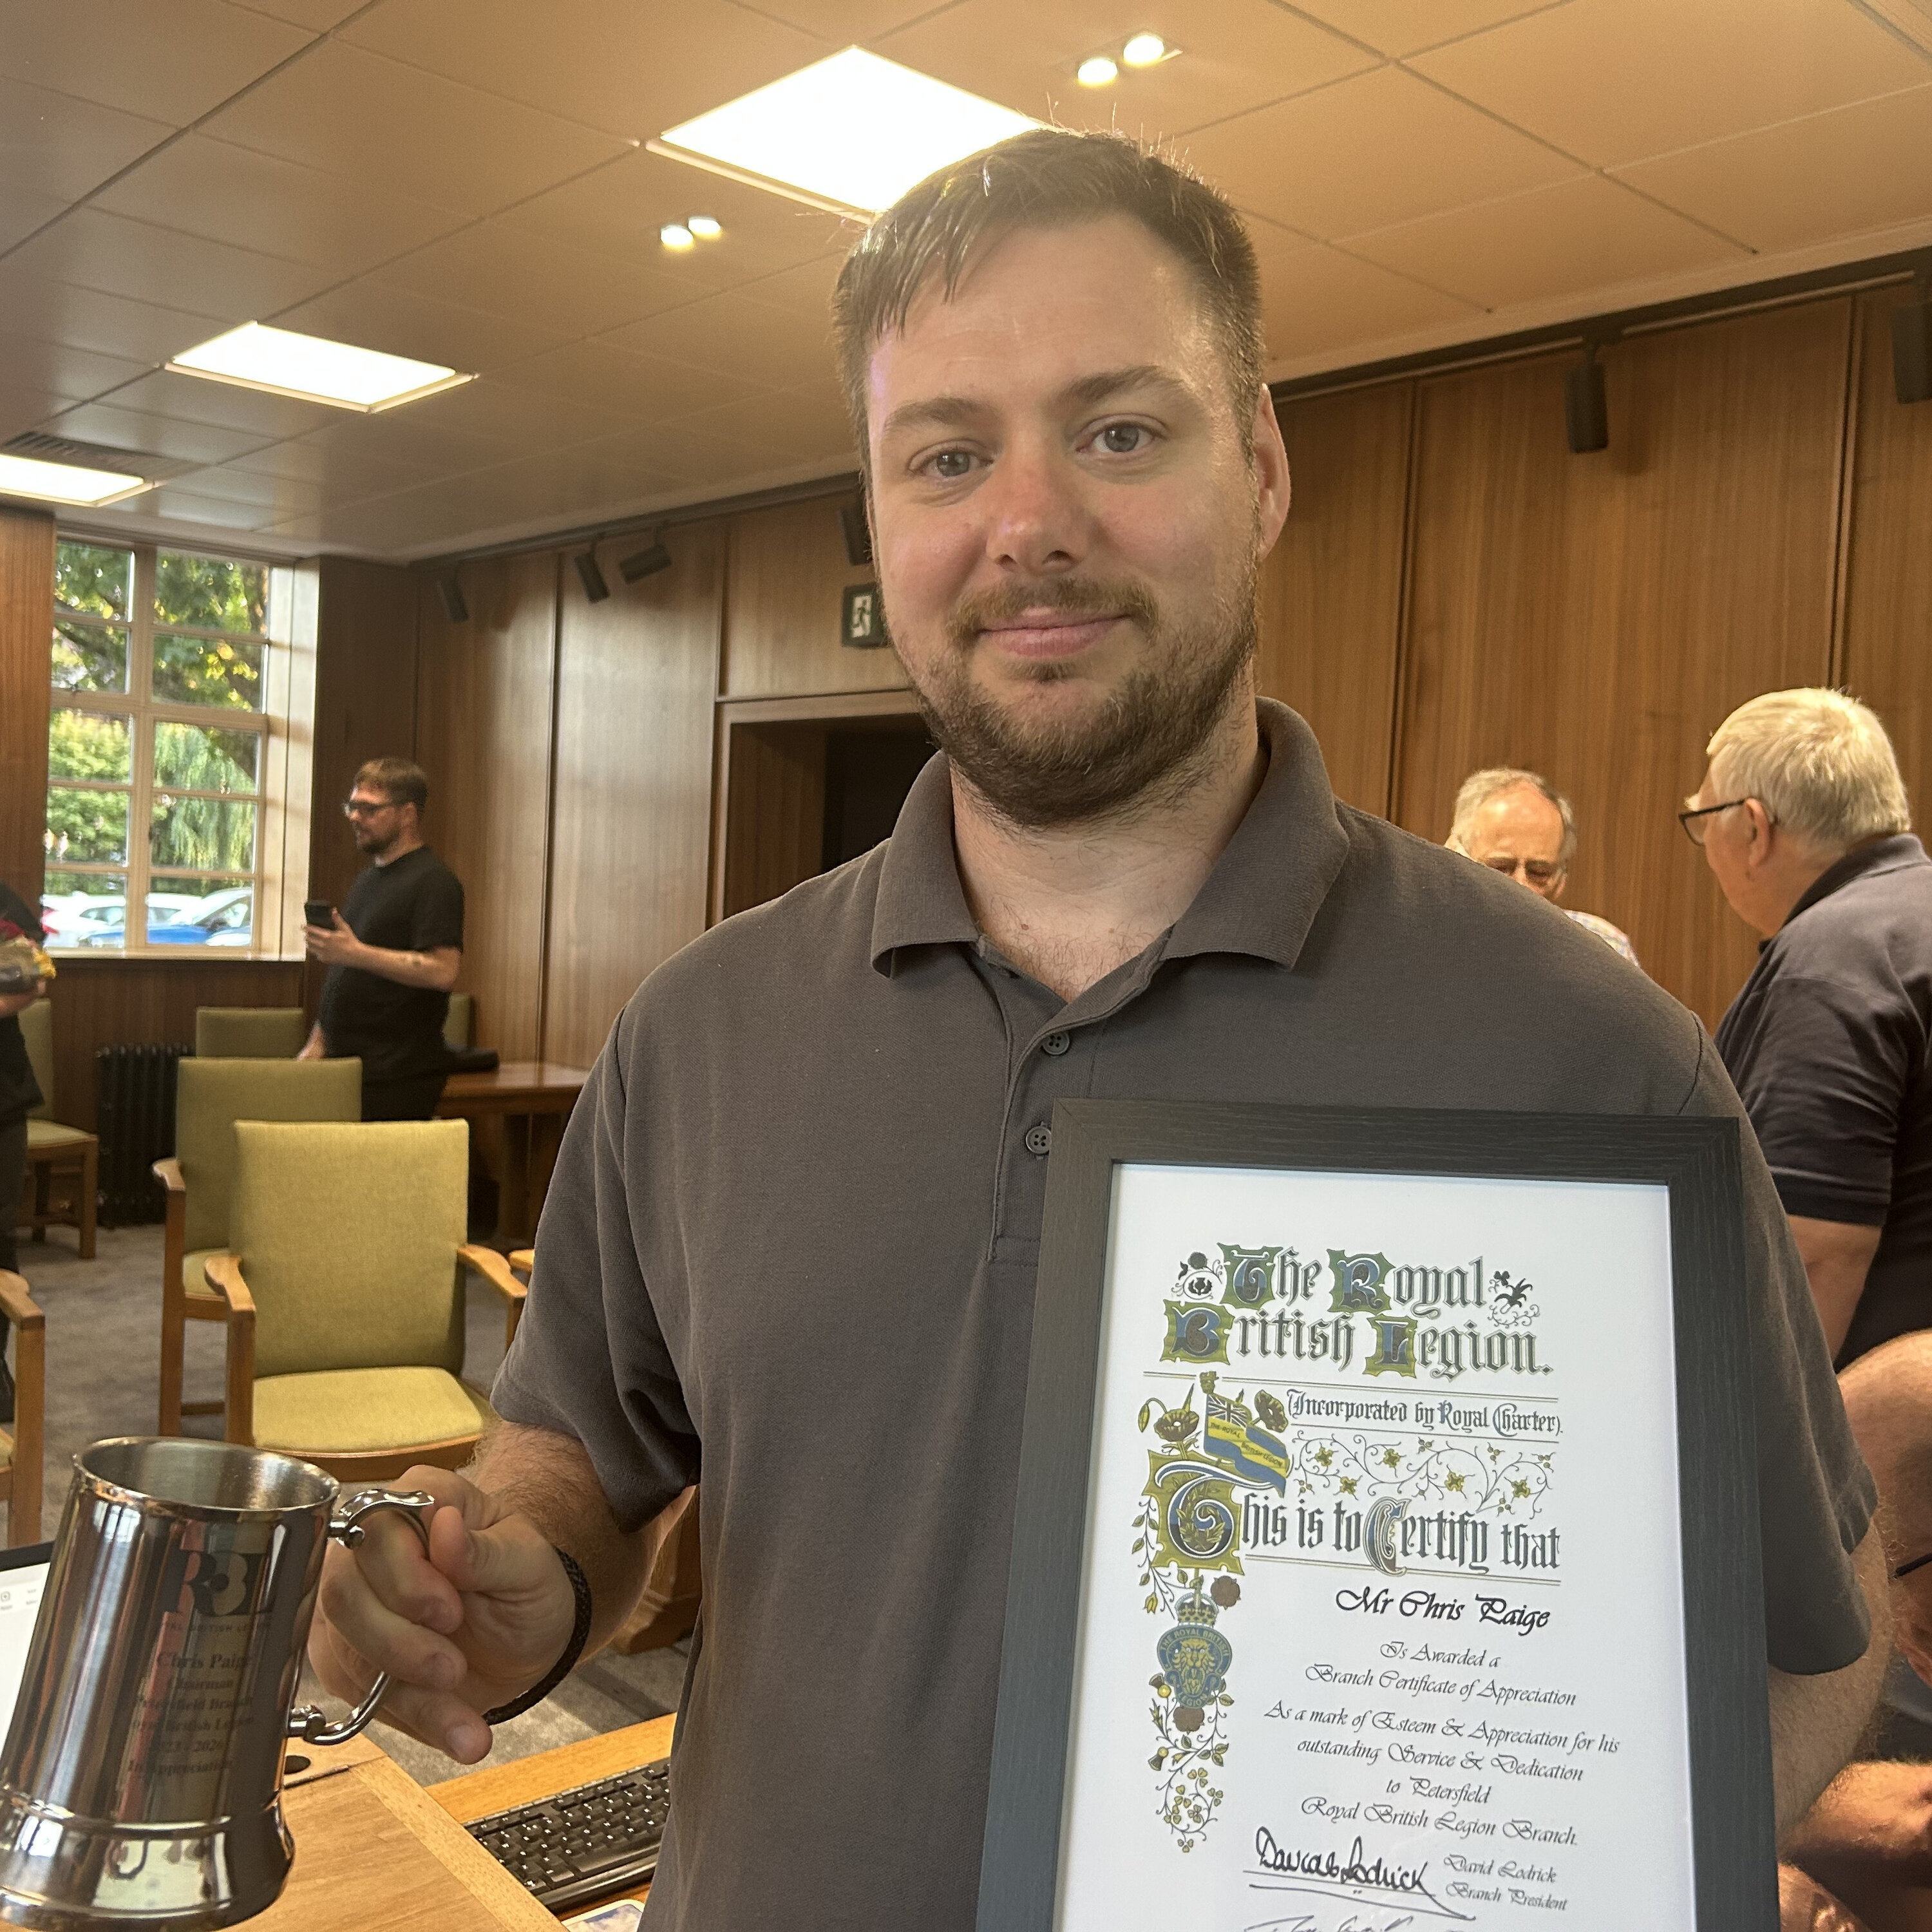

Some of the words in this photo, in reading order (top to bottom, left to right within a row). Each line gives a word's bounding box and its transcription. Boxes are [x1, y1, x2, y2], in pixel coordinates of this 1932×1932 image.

[1224, 1244, 1322, 1307] The
[1331, 1251, 1486, 1320] Royal
[1162, 1302, 1356, 1372] British
[1370, 1316, 1554, 1383] Legion.
[1222, 1425, 1242, 1439] ROYAL
[1414, 1401, 1435, 1431] by
[1437, 1399, 1490, 1434] Royal
[1262, 1453, 1283, 1468] LEGION
[1153, 1458, 1287, 1560] This
[1295, 1498, 1325, 1549] is
[1331, 1499, 1364, 1553] to
[1362, 1495, 1490, 1577] Certify
[1500, 1520, 1562, 1570] that
[1335, 1586, 1394, 1615] Mr
[1398, 1589, 1465, 1621] Chris
[1474, 1593, 1551, 1636] Paige
[1160, 1634, 1173, 1651] THE
[1173, 1627, 1201, 1639] ROYAL
[1202, 1629, 1230, 1657] BRITISH
[1379, 1640, 1408, 1659] Is
[1410, 1643, 1487, 1667] Awarded
[1488, 1656, 1502, 1667] a
[156, 1651, 204, 1669] Chris
[1177, 1691, 1209, 1706] LEGION
[1305, 1662, 1374, 1687] Branch
[1378, 1669, 1457, 1698] Certificate
[1459, 1678, 1481, 1702] of
[1476, 1678, 1577, 1706] Appreciation
[1263, 1699, 1293, 1719] As
[1294, 1709, 1308, 1721] a
[1309, 1707, 1349, 1726] mark
[1351, 1710, 1372, 1733] of
[1371, 1711, 1437, 1734] Esteem
[1441, 1718, 1465, 1737] &
[1466, 1719, 1568, 1748] Appreciation
[1566, 1730, 1596, 1756] for
[1597, 1733, 1621, 1753] his
[1296, 1739, 1383, 1766] outstanding
[1387, 1742, 1457, 1767] Service
[1459, 1750, 1485, 1770] &
[1490, 1752, 1584, 1781] Dedication
[1385, 1779, 1401, 1794] to
[1409, 1775, 1492, 1807] Petersfield
[1300, 1795, 1361, 1824] Royal
[1363, 1803, 1429, 1828] British
[1434, 1810, 1497, 1840] Legion
[1443, 1853, 1495, 1875] David
[1497, 1859, 1557, 1884] Lodrick
[1445, 1880, 1502, 1903] Branch
[1508, 1887, 1569, 1911] President
